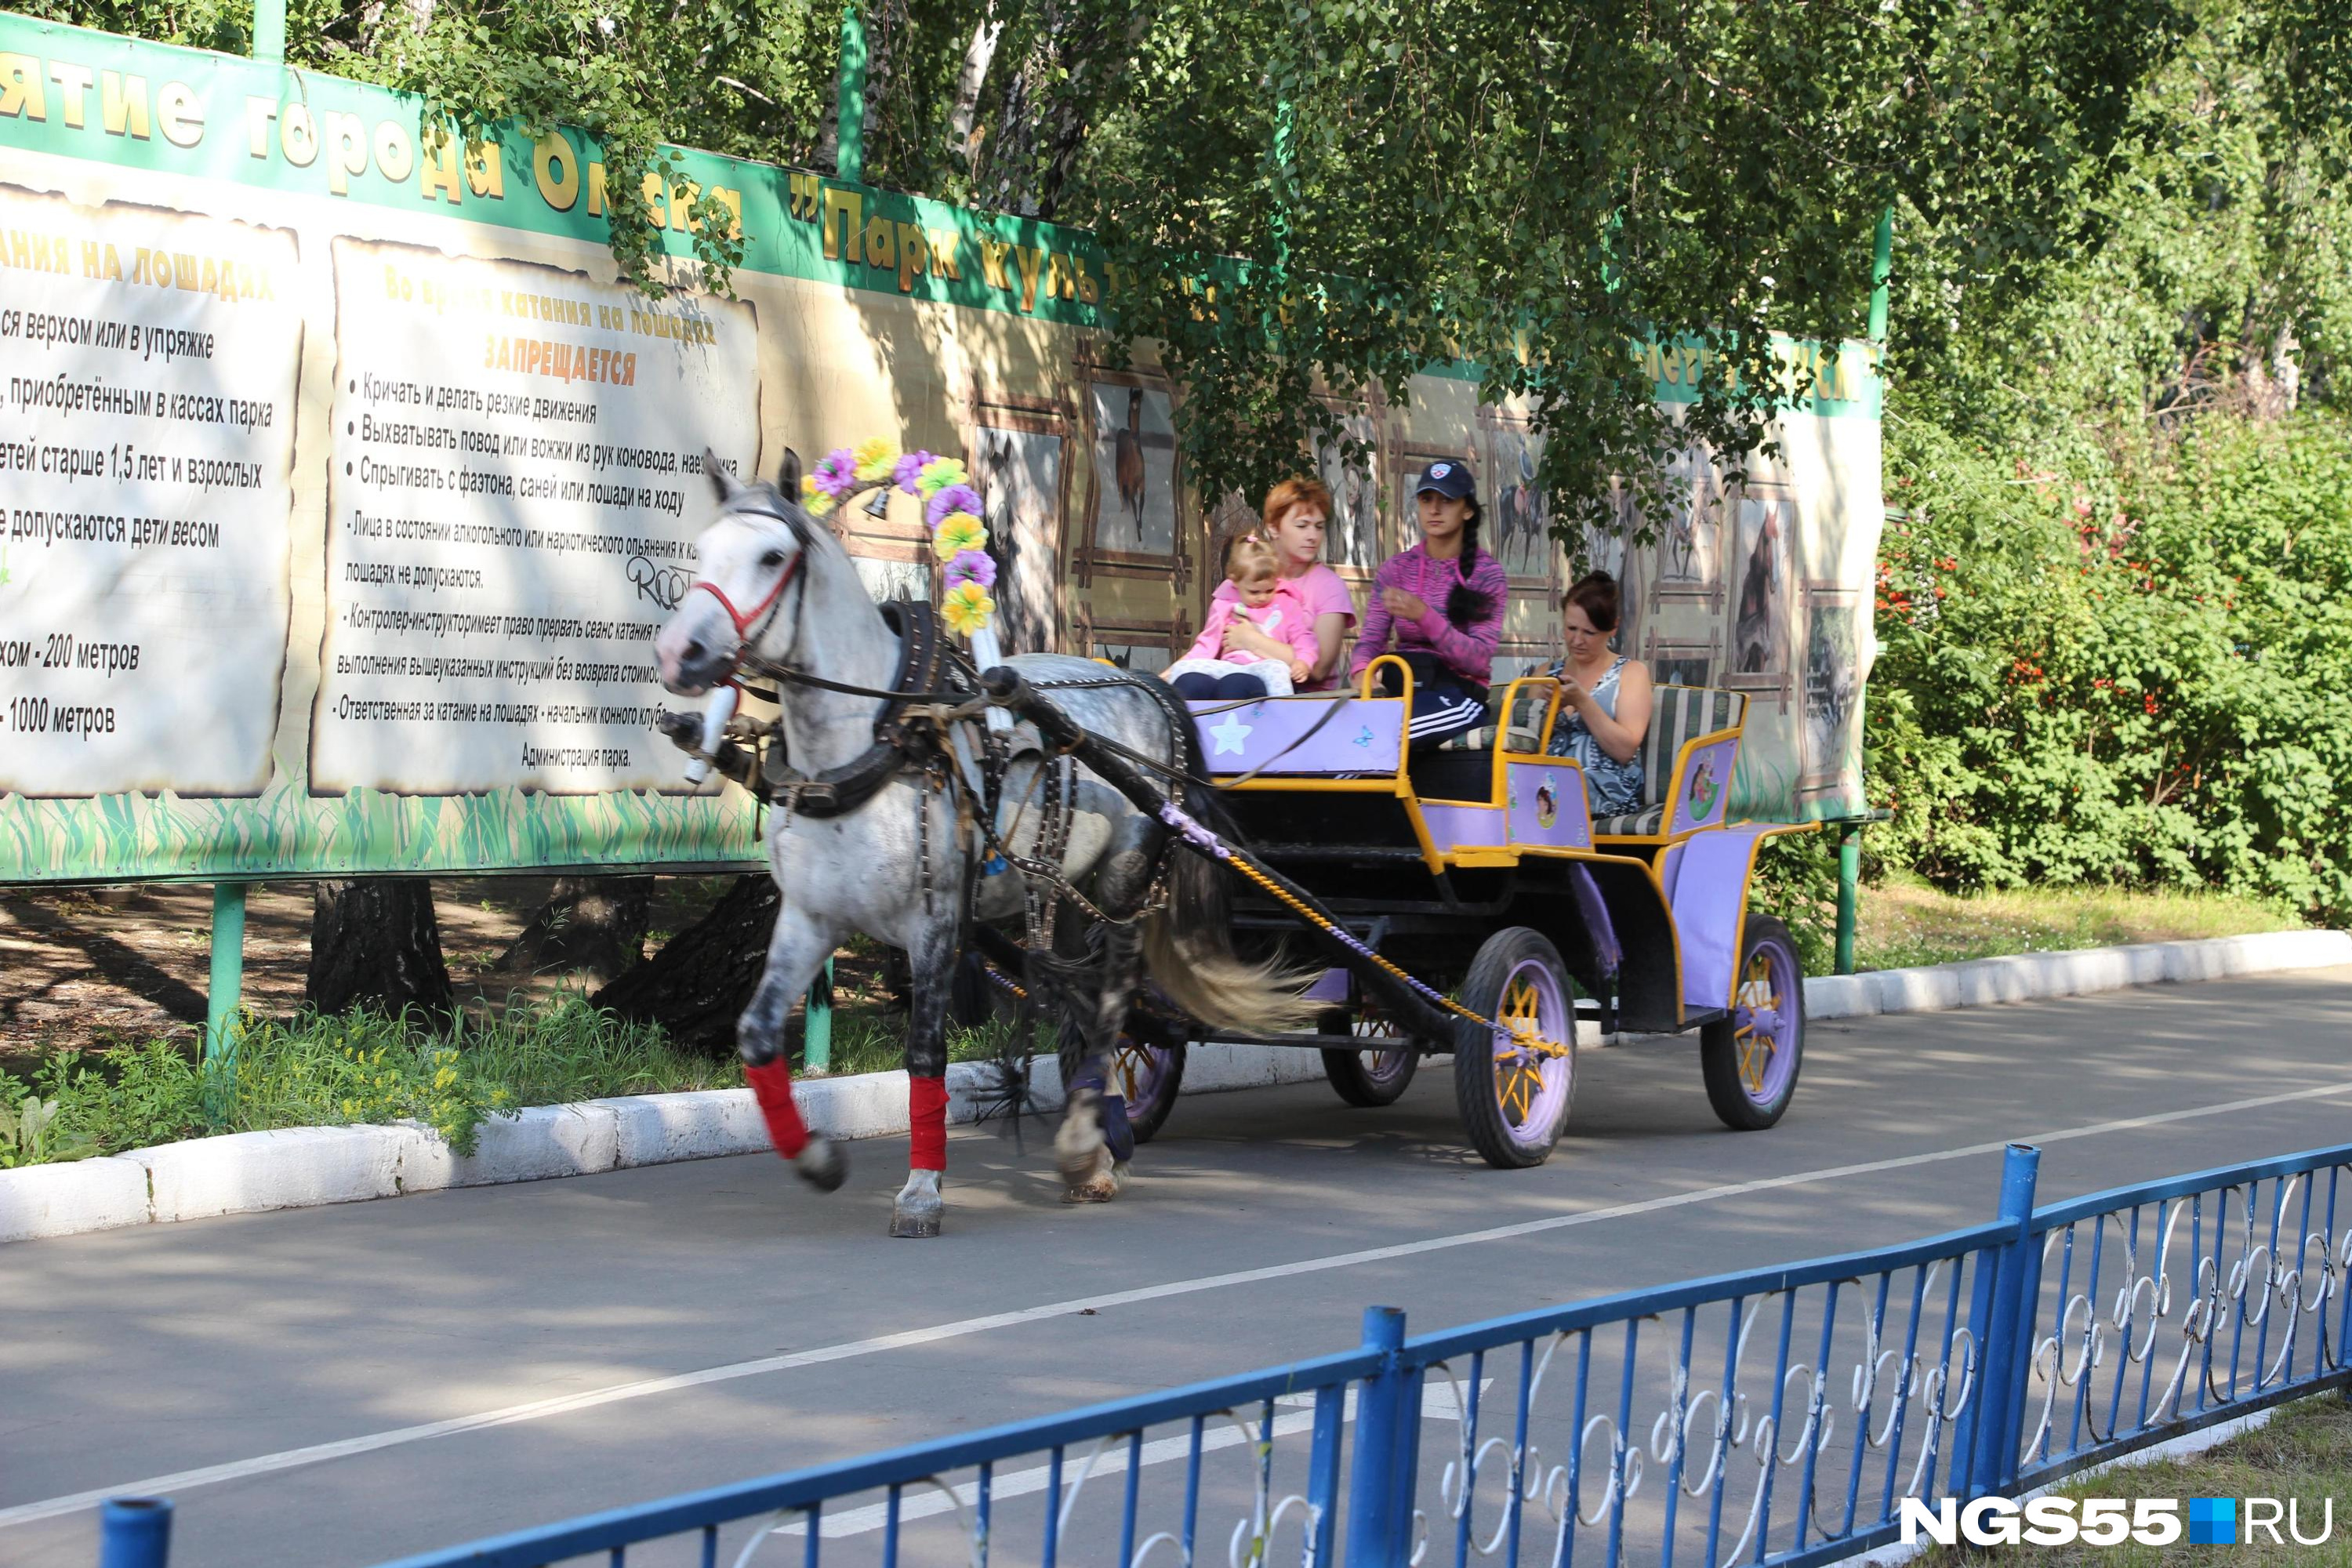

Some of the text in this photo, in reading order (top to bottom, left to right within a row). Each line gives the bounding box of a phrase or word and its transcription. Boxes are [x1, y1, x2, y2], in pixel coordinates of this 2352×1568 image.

[246, 94, 504, 205] города
[81, 239, 123, 282] НА
[133, 247, 275, 303] ЛОШАДЯХ
[26, 312, 92, 350] верхом
[96, 321, 126, 349] или
[130, 325, 140, 350] в
[143, 327, 214, 362] упряжке
[502, 290, 592, 327] катания
[598, 304, 624, 332] на
[630, 310, 717, 347] лошадях
[485, 333, 636, 387] ЗАПРЕЩАЕТСЯ
[11, 373, 273, 434] приобретённым в кассах парка
[363, 372, 597, 424] Кричать и делать резкие движения
[42, 446, 104, 483] старше
[111, 443, 133, 485] 1,5
[137, 454, 166, 481] лет
[172, 457, 182, 482] и
[188, 459, 262, 493] взрослых
[362, 413, 456, 449] Выхватывать
[461, 430, 499, 459] повод
[503, 434, 528, 456] или
[532, 437, 573, 461] вожжи
[576, 443, 590, 463] из
[593, 444, 614, 471] рук
[617, 446, 677, 477] коновода,
[361, 456, 684, 517] Спрыгивать с фаэтона, саней или лошади на ходу
[12, 510, 125, 547] допускаются
[131, 518, 169, 549] дети
[171, 520, 219, 548] весом
[354, 510, 382, 541] Лица
[386, 518, 393, 538] в
[396, 519, 451, 541] состоянии
[454, 524, 521, 547] алкогольного
[524, 528, 543, 548] или
[547, 531, 623, 555] наркотического
[626, 535, 676, 559] опьянения
[346, 562, 484, 592] лошадях не допускаются.
[503, 616, 534, 641] право
[535, 618, 583, 642] прервать
[586, 620, 613, 639] сеанс
[615, 621, 652, 641] катания
[42, 633, 73, 669] 200
[77, 642, 140, 678] метров
[337, 655, 662, 688] выполнения вышеуказанных инструкций без возврата стоимос
[10, 696, 48, 732] 1000
[53, 706, 115, 741] метров
[339, 694, 421, 720] Ответственная
[423, 702, 434, 721] за
[437, 702, 476, 722] катание
[479, 703, 491, 722] на
[494, 703, 539, 727] лошадях
[547, 705, 598, 724] начальник
[600, 706, 637, 724] конного
[521, 742, 631, 772] Администрация парка.
